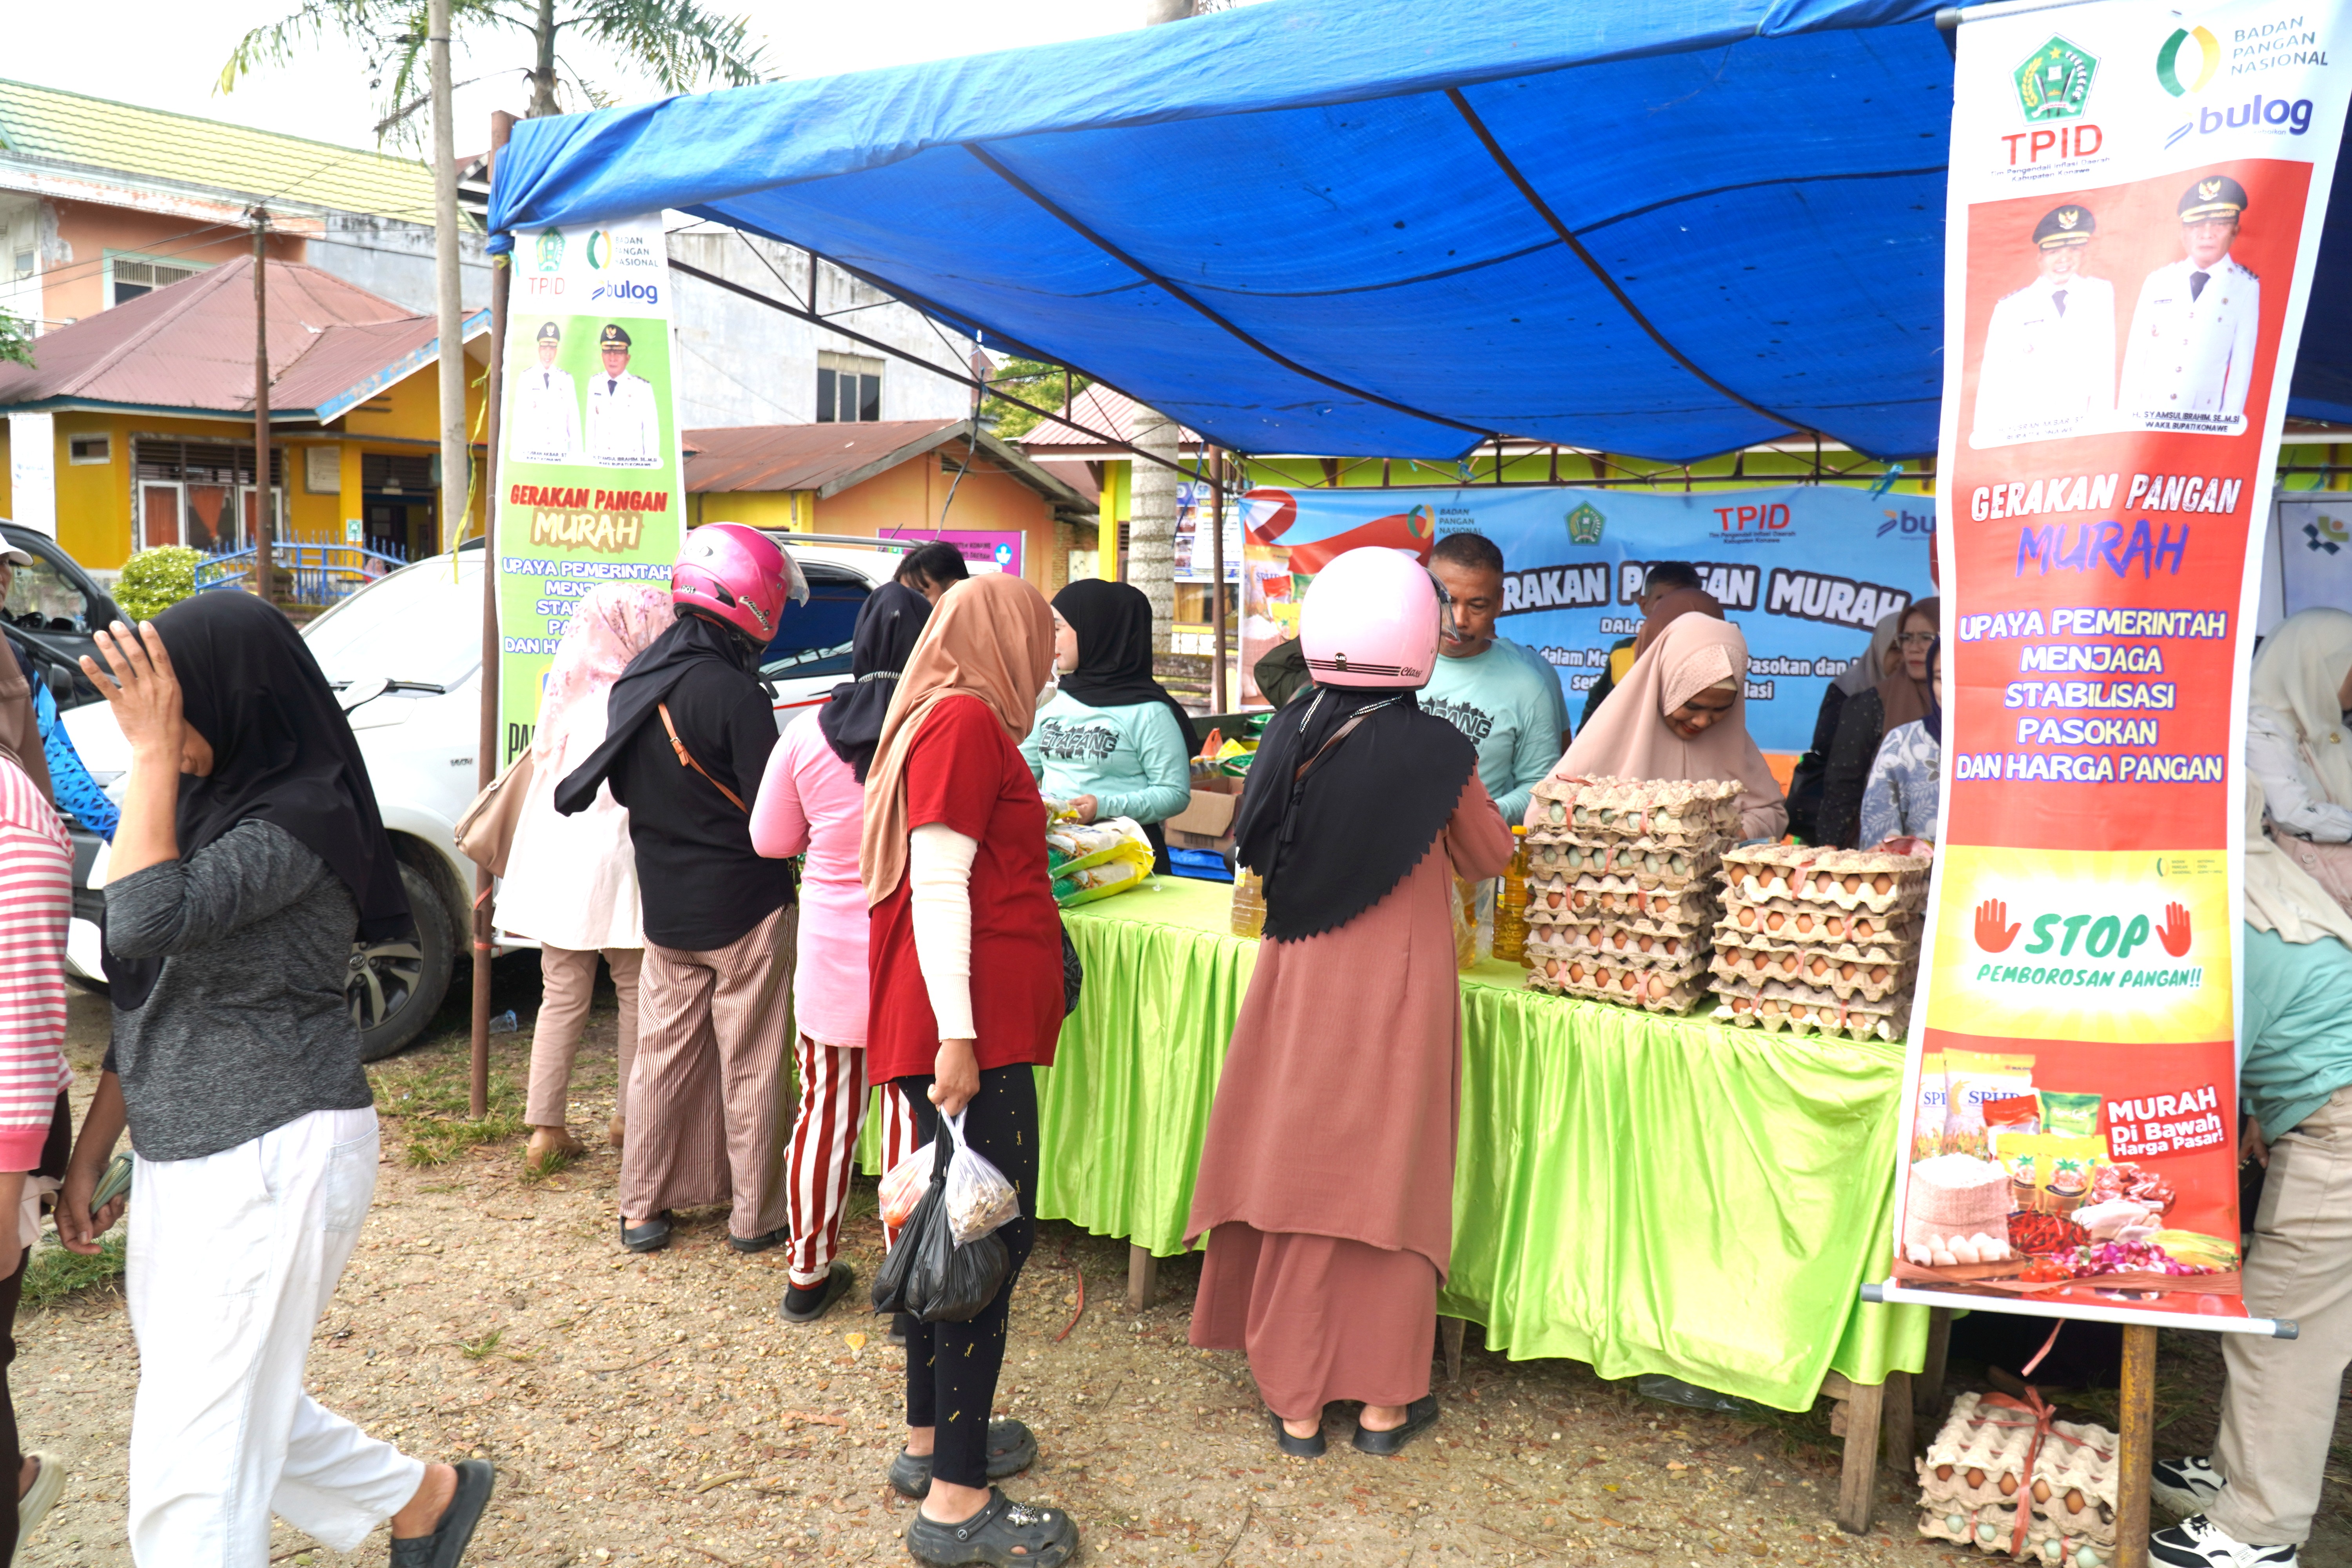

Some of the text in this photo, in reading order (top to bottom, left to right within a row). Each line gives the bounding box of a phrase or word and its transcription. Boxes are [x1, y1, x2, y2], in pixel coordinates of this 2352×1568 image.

[2234, 16, 2303, 42] BADAN
[2233, 32, 2315, 59] PANGAN
[2231, 51, 2328, 76] NASIONAL
[2199, 94, 2313, 136] bulog
[2001, 124, 2102, 165] TPID
[615, 236, 643, 245] BADAN
[529, 277, 564, 295] TPID
[607, 280, 658, 305] bulog
[2172, 422, 2196, 430] BUPATI
[2197, 423, 2228, 432] KONAWE
[510, 484, 668, 512] GERAKAN PANGAN
[1971, 474, 2242, 522] GERAKAN PANGAN
[534, 511, 639, 549] MURAH
[1713, 504, 1790, 530] TPID
[2015, 519, 2189, 579] MURAH
[503, 557, 673, 580] UPAYA PEMERINTAH
[681, 585, 695, 593] DOT
[1502, 568, 1606, 612] RAKAN
[1770, 572, 1906, 628] MURAH
[1960, 608, 2228, 641] UPAYA PEMERINTAH
[504, 637, 540, 653] DAN
[1815, 657, 1847, 676] dan
[2019, 645, 2164, 674] MENJAGA
[2004, 681, 2176, 710] STABILISASI
[2017, 717, 2159, 746] PASOKAN
[1956, 753, 2223, 782] DAN HARGA PANGAN
[2024, 913, 2150, 958] STOP
[1977, 964, 2203, 988] PEMBOROSAN PANGAN!!
[2108, 1086, 2217, 1123] MURAH
[2111, 1112, 2220, 1143] Di Bawah
[2113, 1128, 2224, 1156] Harga Pasar!
